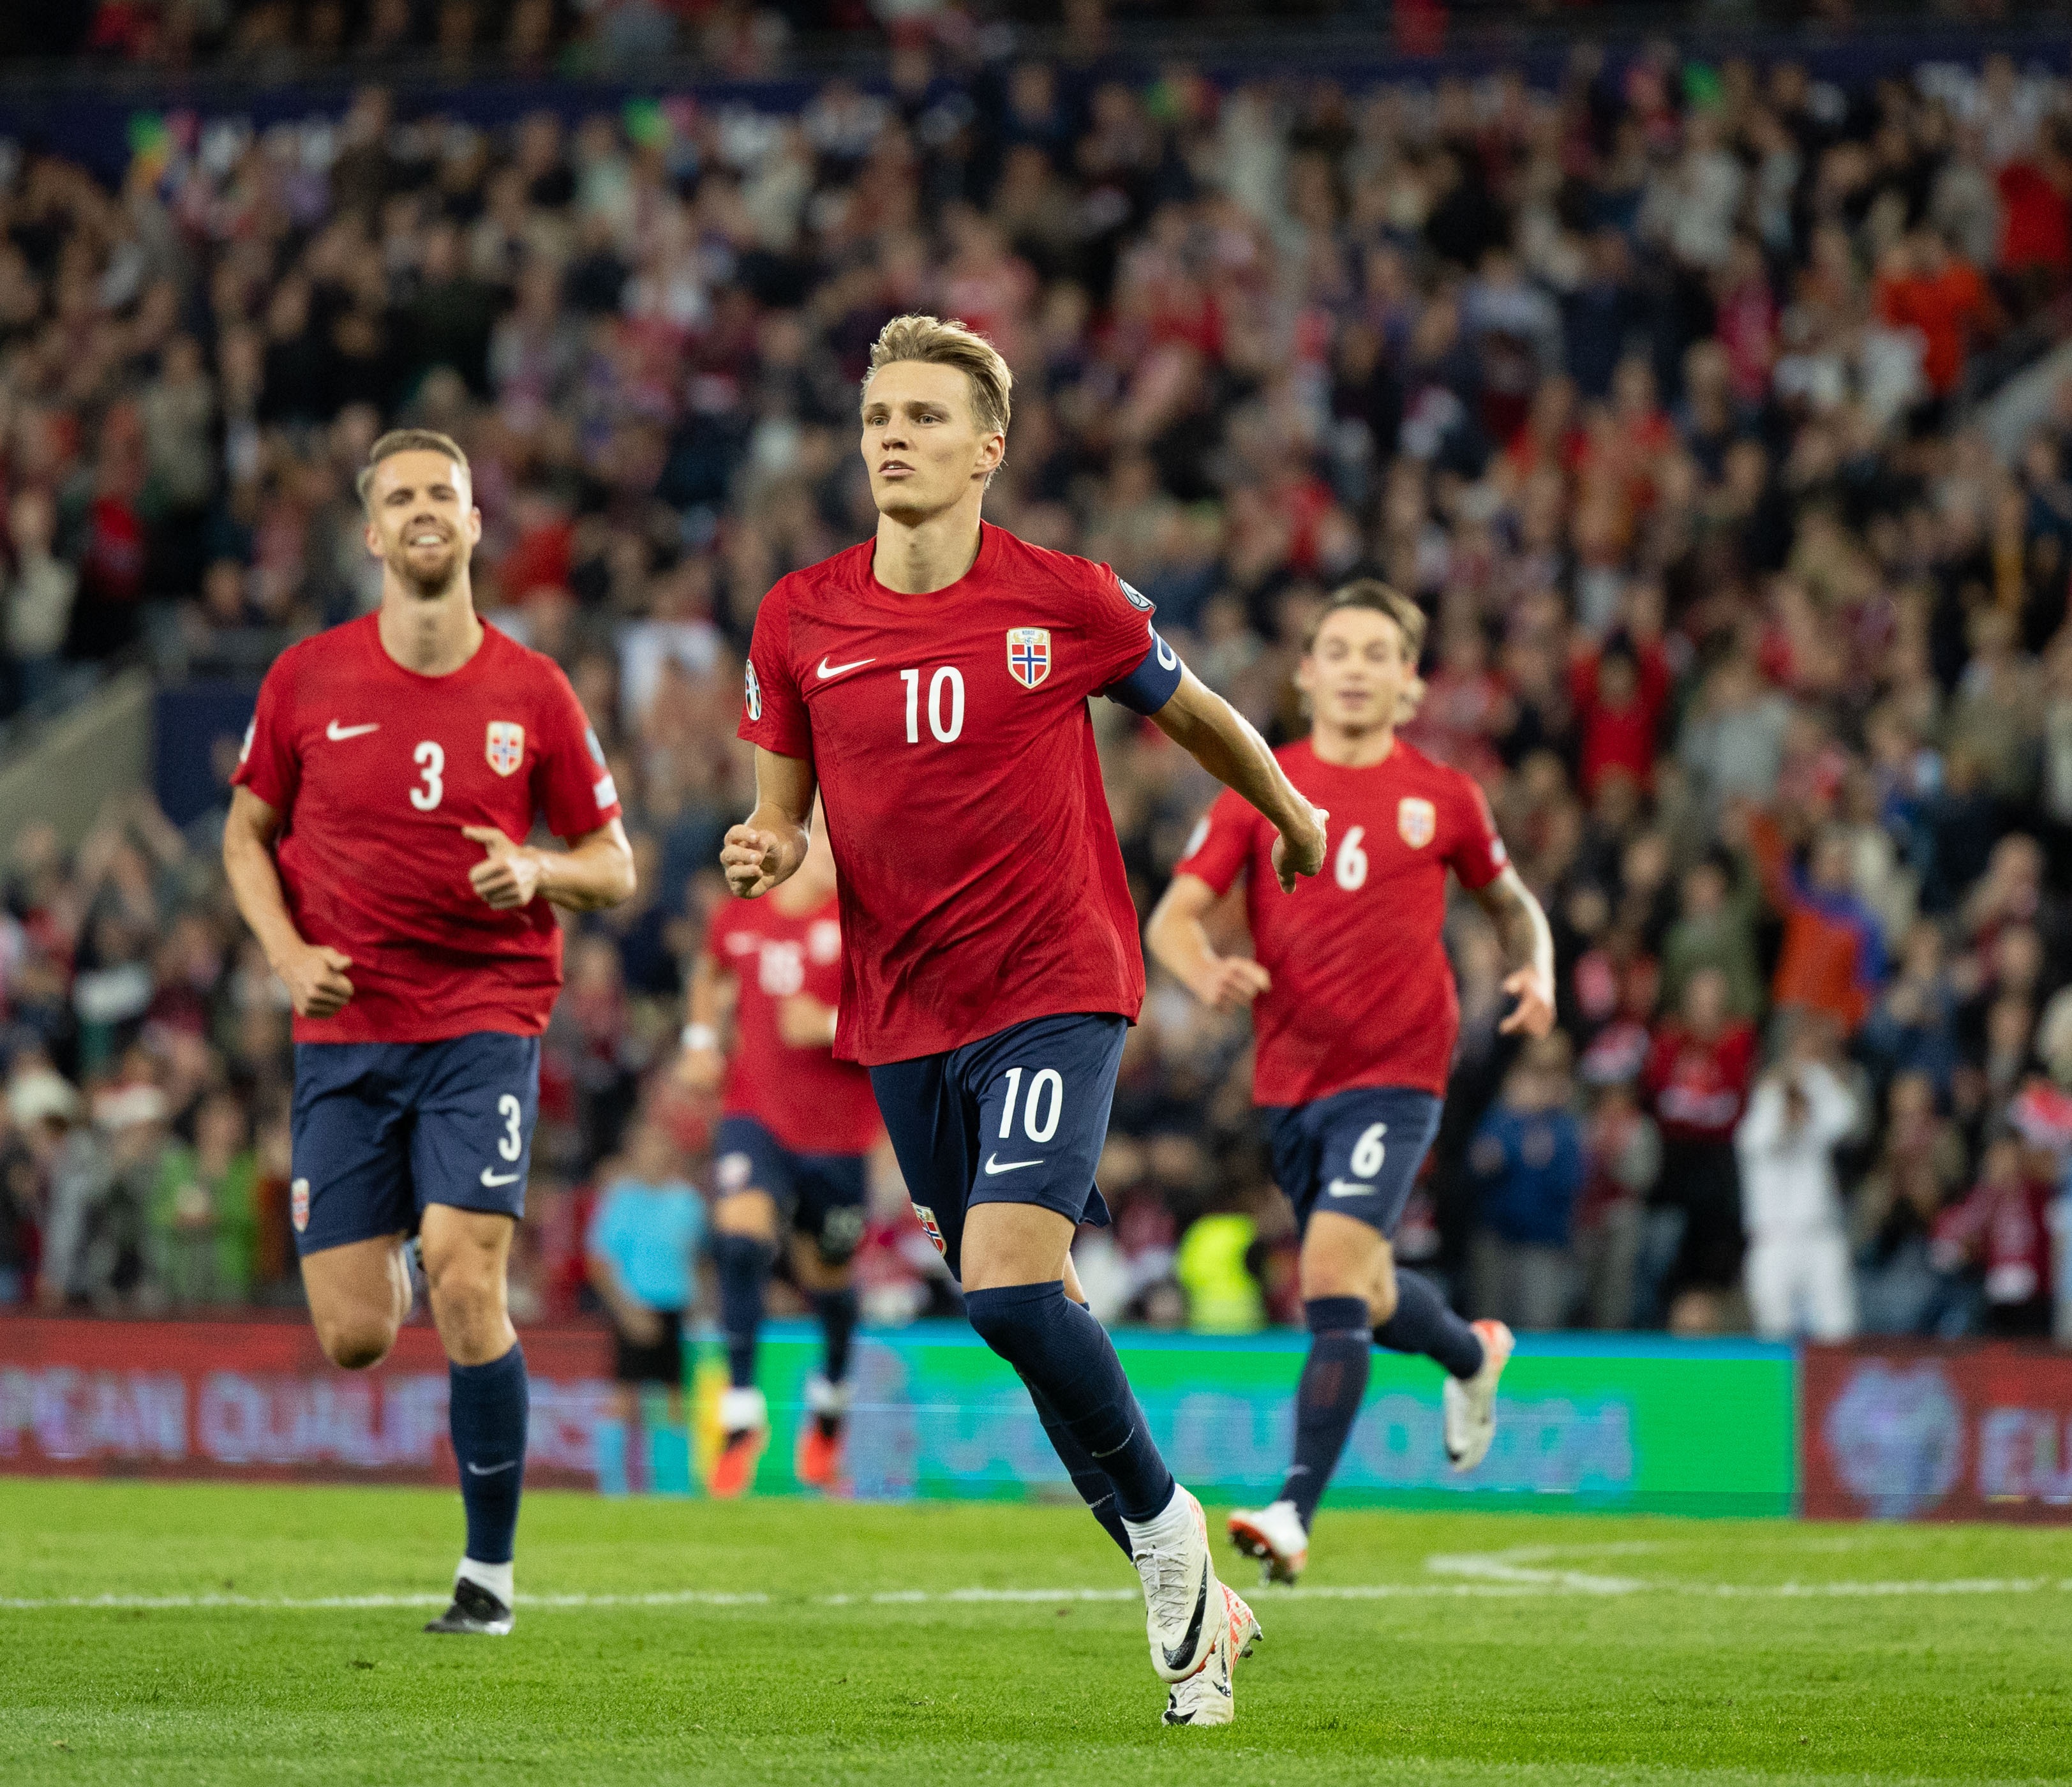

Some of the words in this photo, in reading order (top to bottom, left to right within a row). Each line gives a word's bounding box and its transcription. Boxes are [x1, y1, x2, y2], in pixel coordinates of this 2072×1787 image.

[900, 666, 965, 744] 10
[410, 740, 445, 811] 3
[1335, 826, 1368, 891] 6
[498, 1094, 522, 1162] 3
[998, 1067, 1063, 1143] 10
[1350, 1123, 1387, 1178] 6
